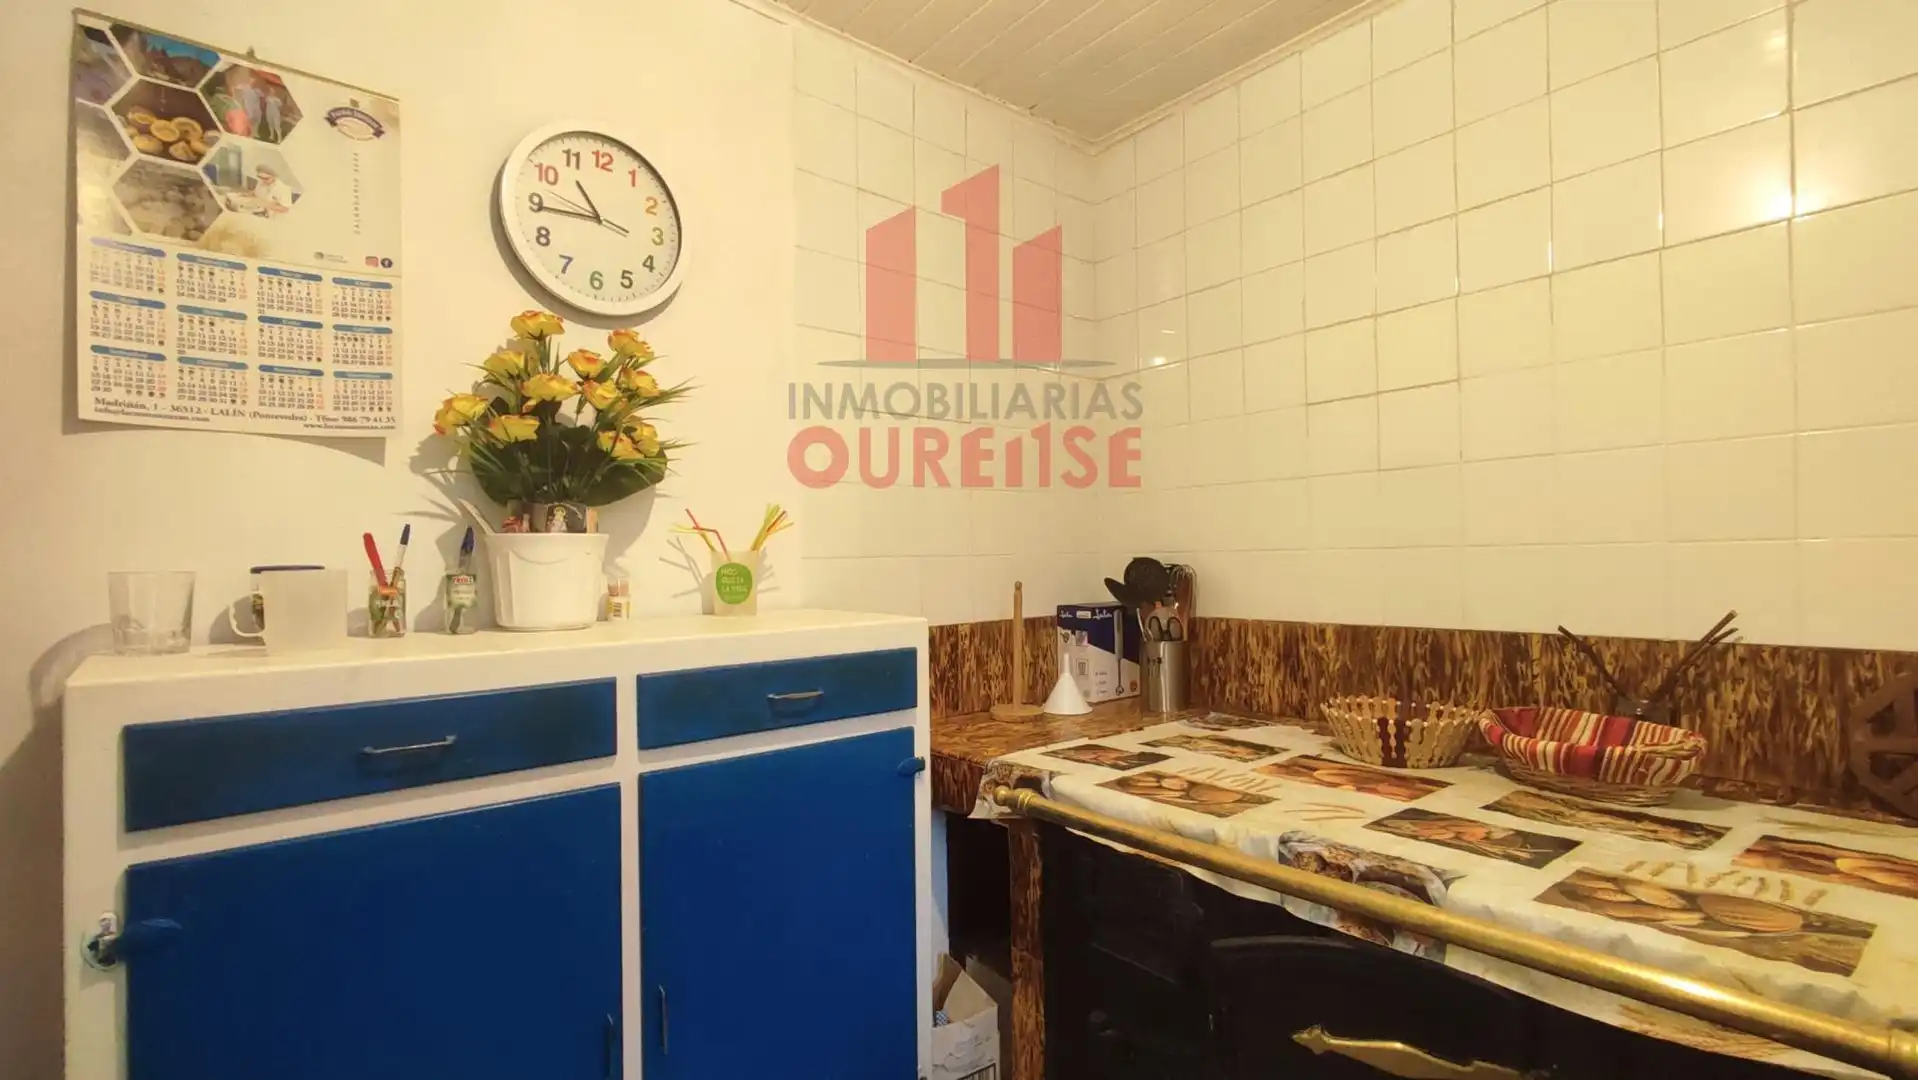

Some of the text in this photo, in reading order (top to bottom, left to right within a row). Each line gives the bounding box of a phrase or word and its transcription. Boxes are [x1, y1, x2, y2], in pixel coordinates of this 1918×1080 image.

[562, 148, 581, 170] 11
[591, 149, 614, 173] 12
[534, 162, 559, 186] 10
[627, 168, 637, 188] 1
[528, 192, 544, 213] 9
[644, 196, 658, 216] 2
[535, 226, 551, 247] 8
[651, 227, 664, 246] 3
[558, 254, 574, 275] 7
[642, 254, 655, 273] 4
[589, 270, 604, 290] 6
[620, 269, 634, 289] 5
